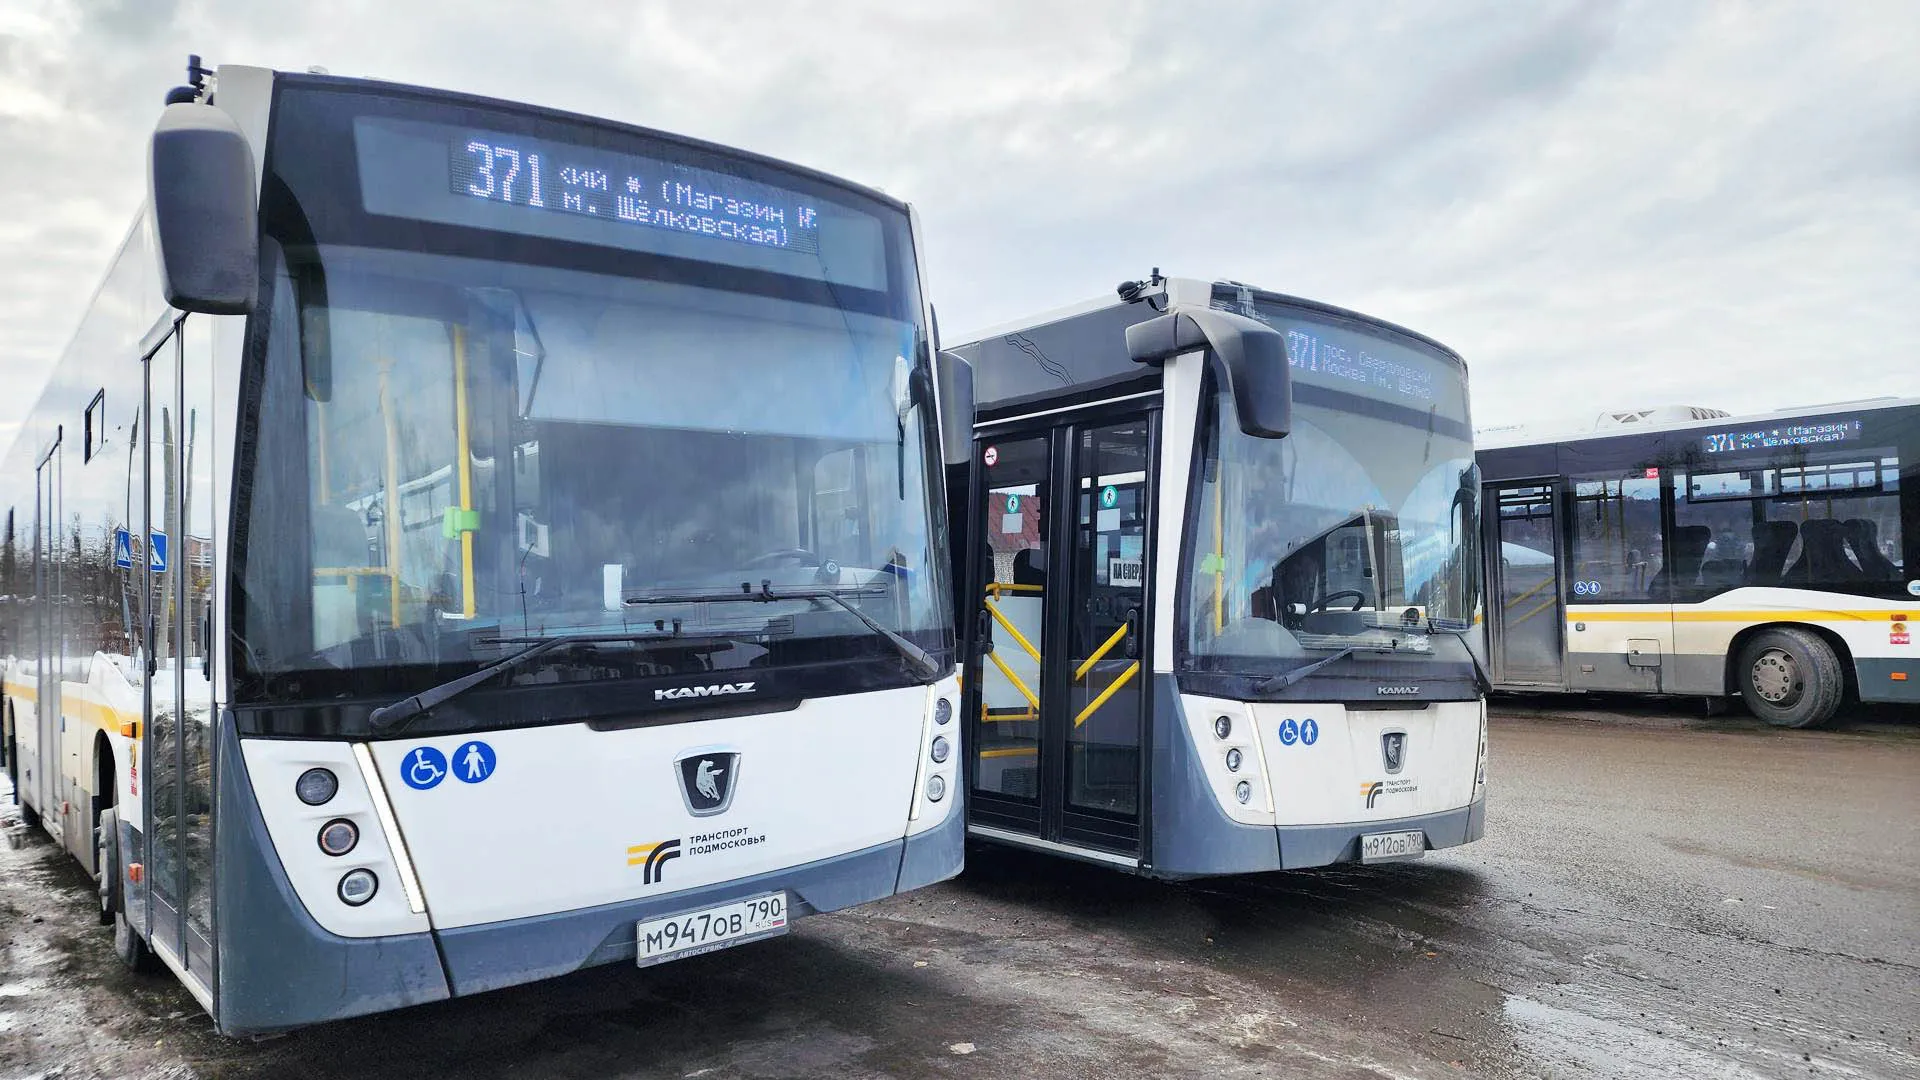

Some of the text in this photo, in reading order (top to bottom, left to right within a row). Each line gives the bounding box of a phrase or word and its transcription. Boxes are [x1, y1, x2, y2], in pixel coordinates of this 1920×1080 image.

[468, 142, 543, 207] 371
[663, 181, 784, 223] (Магазин
[564, 192, 788, 246] м. Щёлковская)
[1288, 331, 1317, 371] 371
[1707, 433, 1735, 453] 371
[1787, 423, 1848, 436] (Магазин
[654, 681, 756, 700] KAMAZ
[1377, 686, 1420, 695] KAMAZ
[689, 827, 749, 844] ТРАНСПОРТ
[689, 835, 766, 856] ПОДМОСКОВЬЯ
[1407, 833, 1423, 848] 790
[747, 897, 781, 923] 790
[755, 919, 772, 929] RUS
